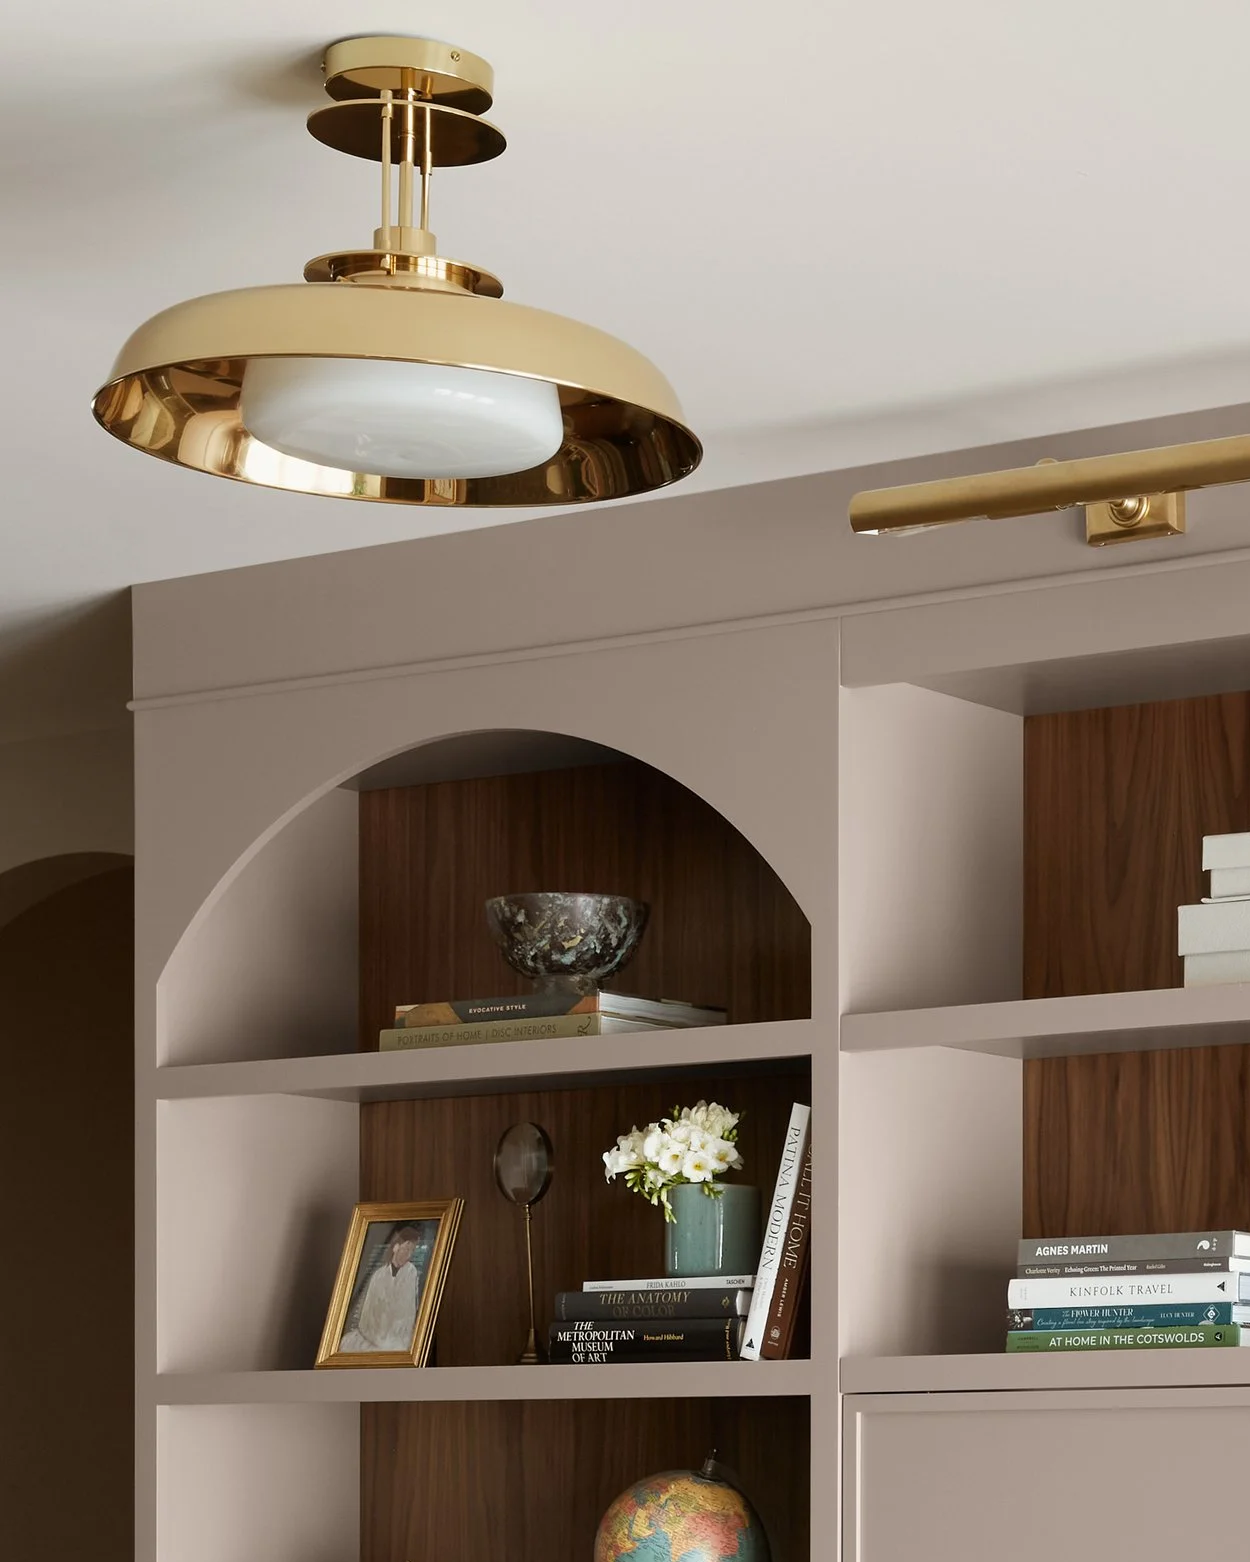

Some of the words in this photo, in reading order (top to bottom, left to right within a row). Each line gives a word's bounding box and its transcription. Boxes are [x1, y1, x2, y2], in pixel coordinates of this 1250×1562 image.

[469, 1004, 505, 1014] EVOCATIVE
[506, 1003, 526, 1012] STYLE
[397, 1033, 440, 1046] PORTRAITS
[441, 1032, 454, 1042] OF
[456, 1030, 482, 1041] HOME
[491, 1026, 511, 1038] DISC
[514, 1023, 558, 1036] INTERIORS
[779, 1127, 801, 1187] PATINA
[796, 1192, 811, 1211] IT
[761, 1194, 787, 1271] MODERN
[783, 1213, 807, 1270] HOME
[1035, 1245, 1069, 1256] AGNES
[1071, 1244, 1109, 1255] MARTIN
[1064, 1266, 1084, 1274] Echoing
[1099, 1264, 1109, 1272] The
[1109, 1264, 1126, 1272] Printed
[646, 1281, 664, 1289] FRIDA
[664, 1280, 686, 1288] KAHLO
[780, 1278, 789, 1300] AMBER
[1069, 1285, 1124, 1297] KINFOLK
[1128, 1284, 1173, 1295] TRAVEL
[599, 1293, 625, 1305] THE
[628, 1291, 691, 1305] ANATOMY
[612, 1306, 629, 1317] OF
[632, 1305, 675, 1317] COLOR
[777, 1300, 785, 1317] LEWIS
[1071, 1309, 1100, 1318] FLOWER
[1101, 1308, 1134, 1317] HUNTER
[574, 1321, 595, 1331] THE
[557, 1330, 635, 1342] METROPOLITAN
[1048, 1337, 1063, 1347] AT
[1065, 1336, 1097, 1346] HOME
[1099, 1336, 1110, 1345] IN
[1113, 1334, 1134, 1344] THE
[1136, 1332, 1205, 1344] COTSWOLDS
[571, 1341, 614, 1352] MUSEUM
[572, 1352, 586, 1363] OF
[587, 1352, 608, 1363] ART
